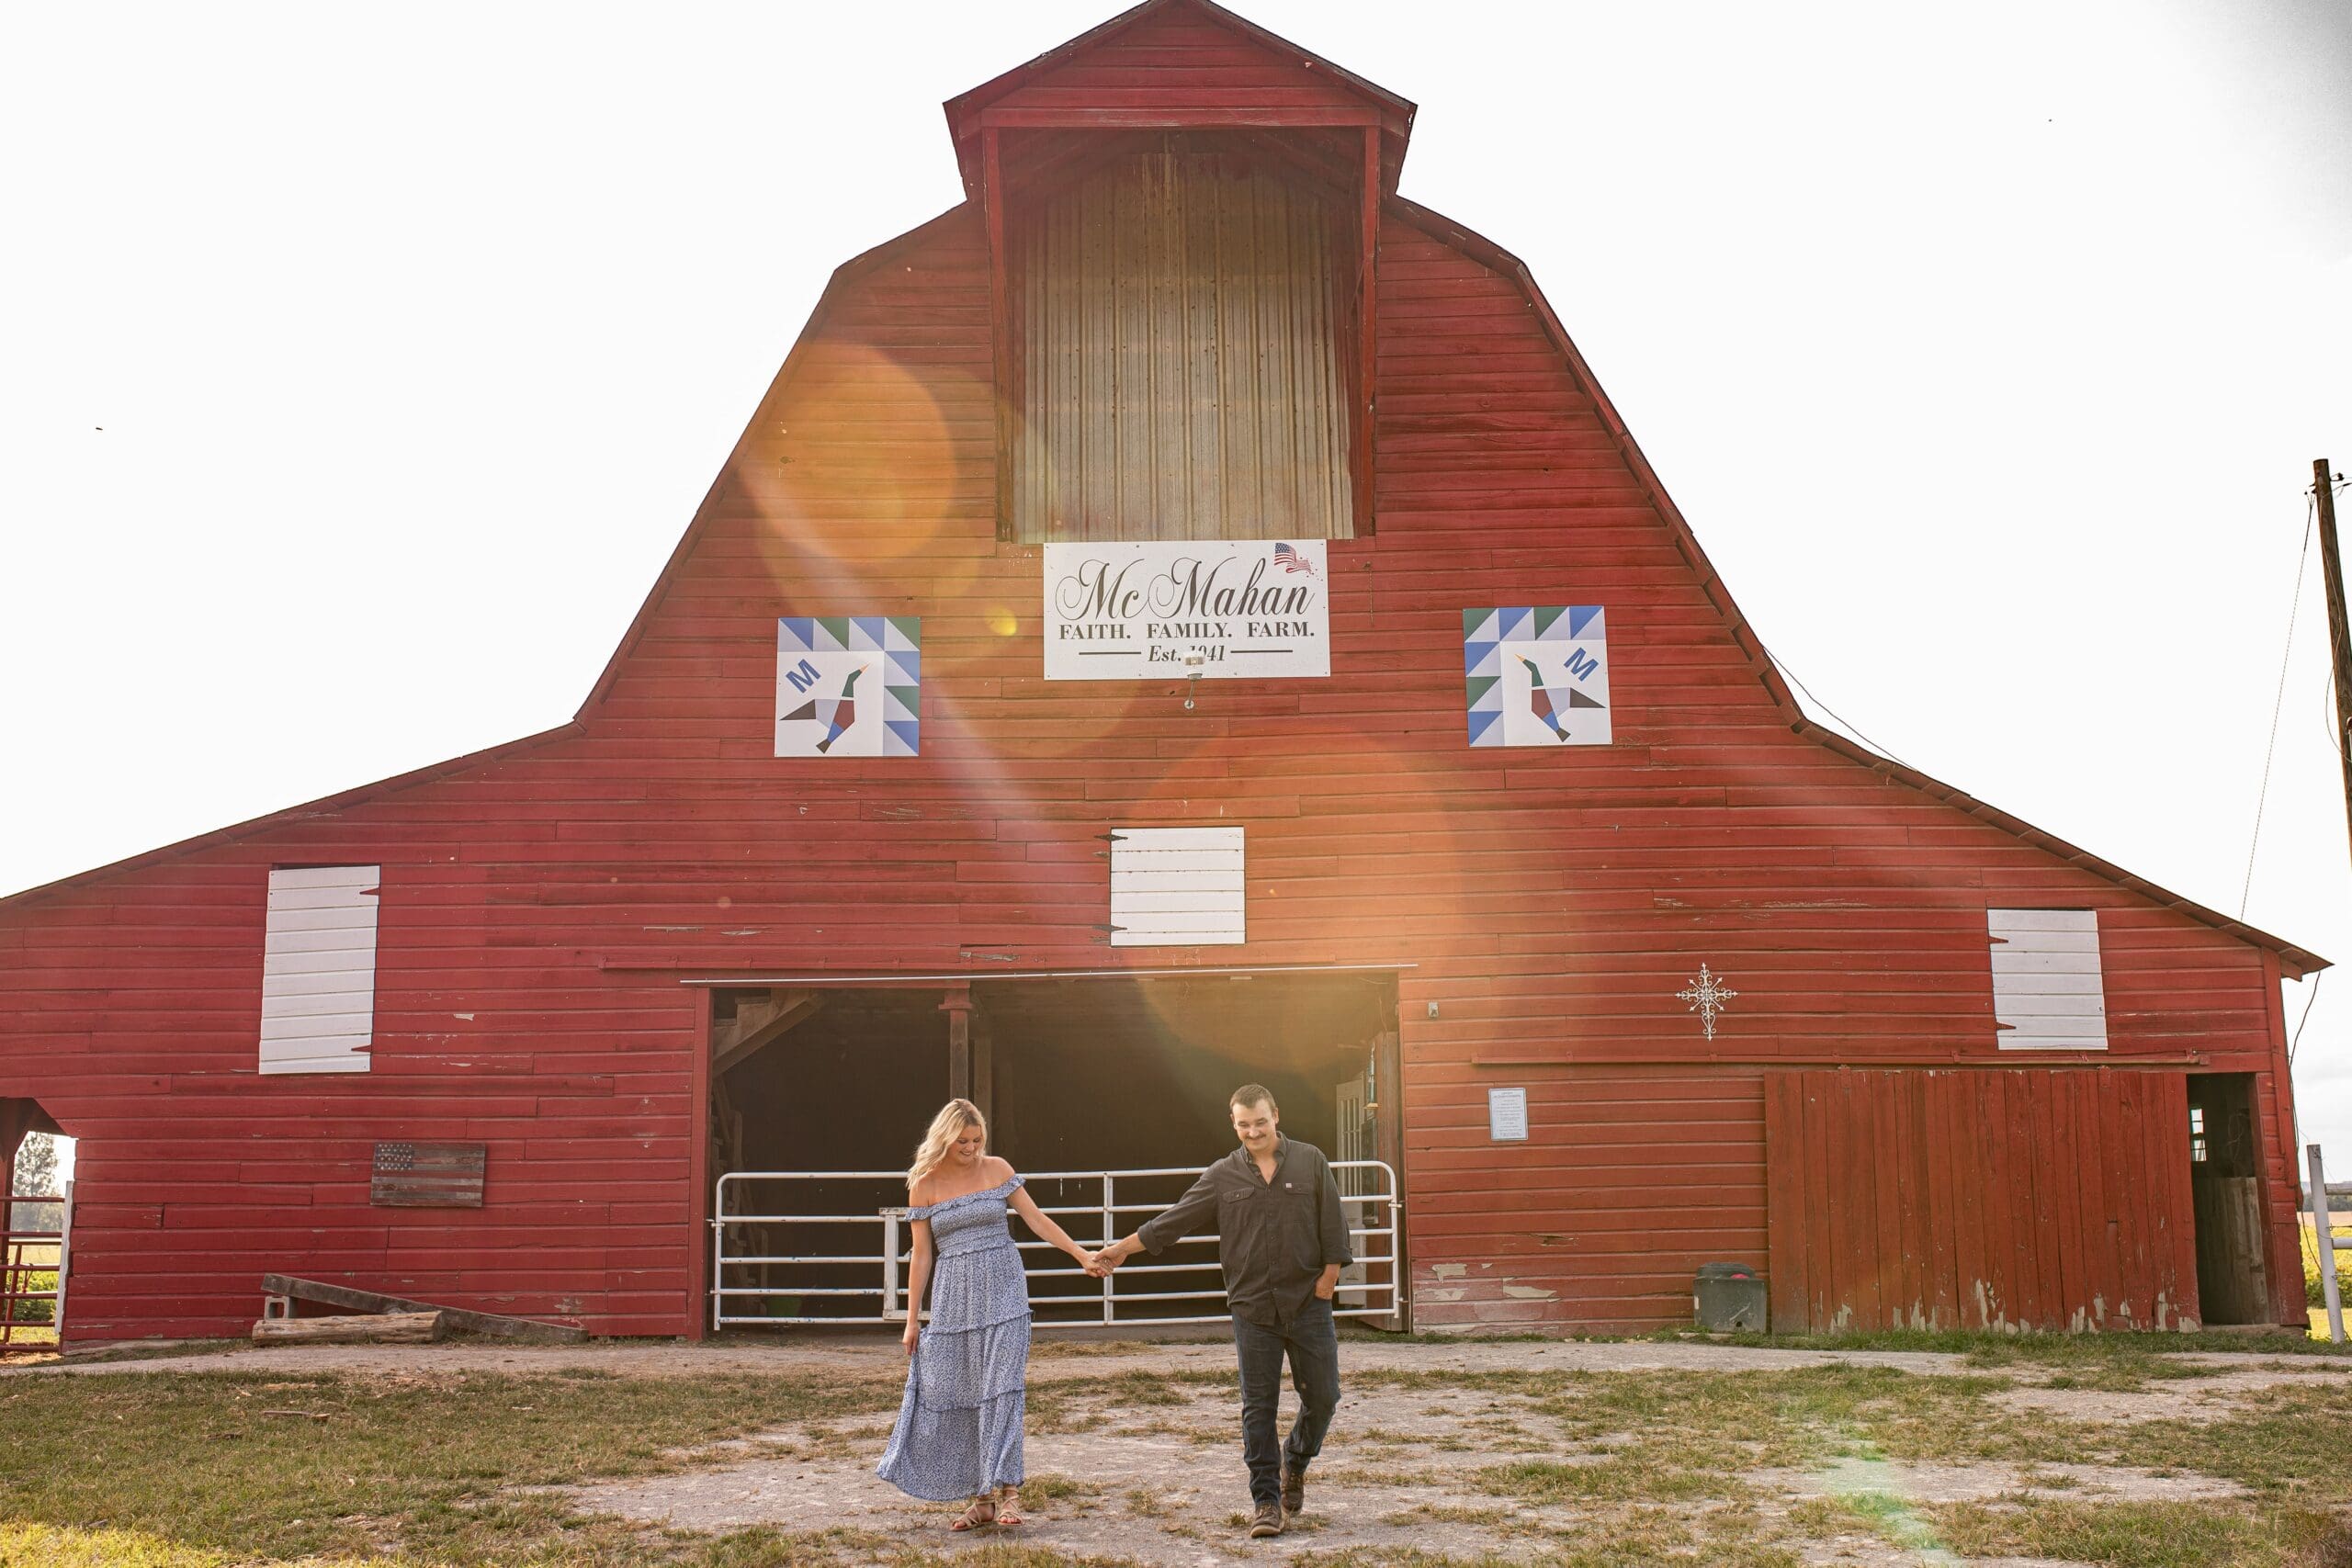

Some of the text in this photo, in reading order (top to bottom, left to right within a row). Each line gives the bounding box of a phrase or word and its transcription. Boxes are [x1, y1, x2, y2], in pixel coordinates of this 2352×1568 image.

[1058, 621, 1316, 640] FAITH. FAMILY. FARM.
[1148, 645, 1182, 662] Est.
[1563, 647, 1600, 682] M
[785, 659, 821, 694] M
